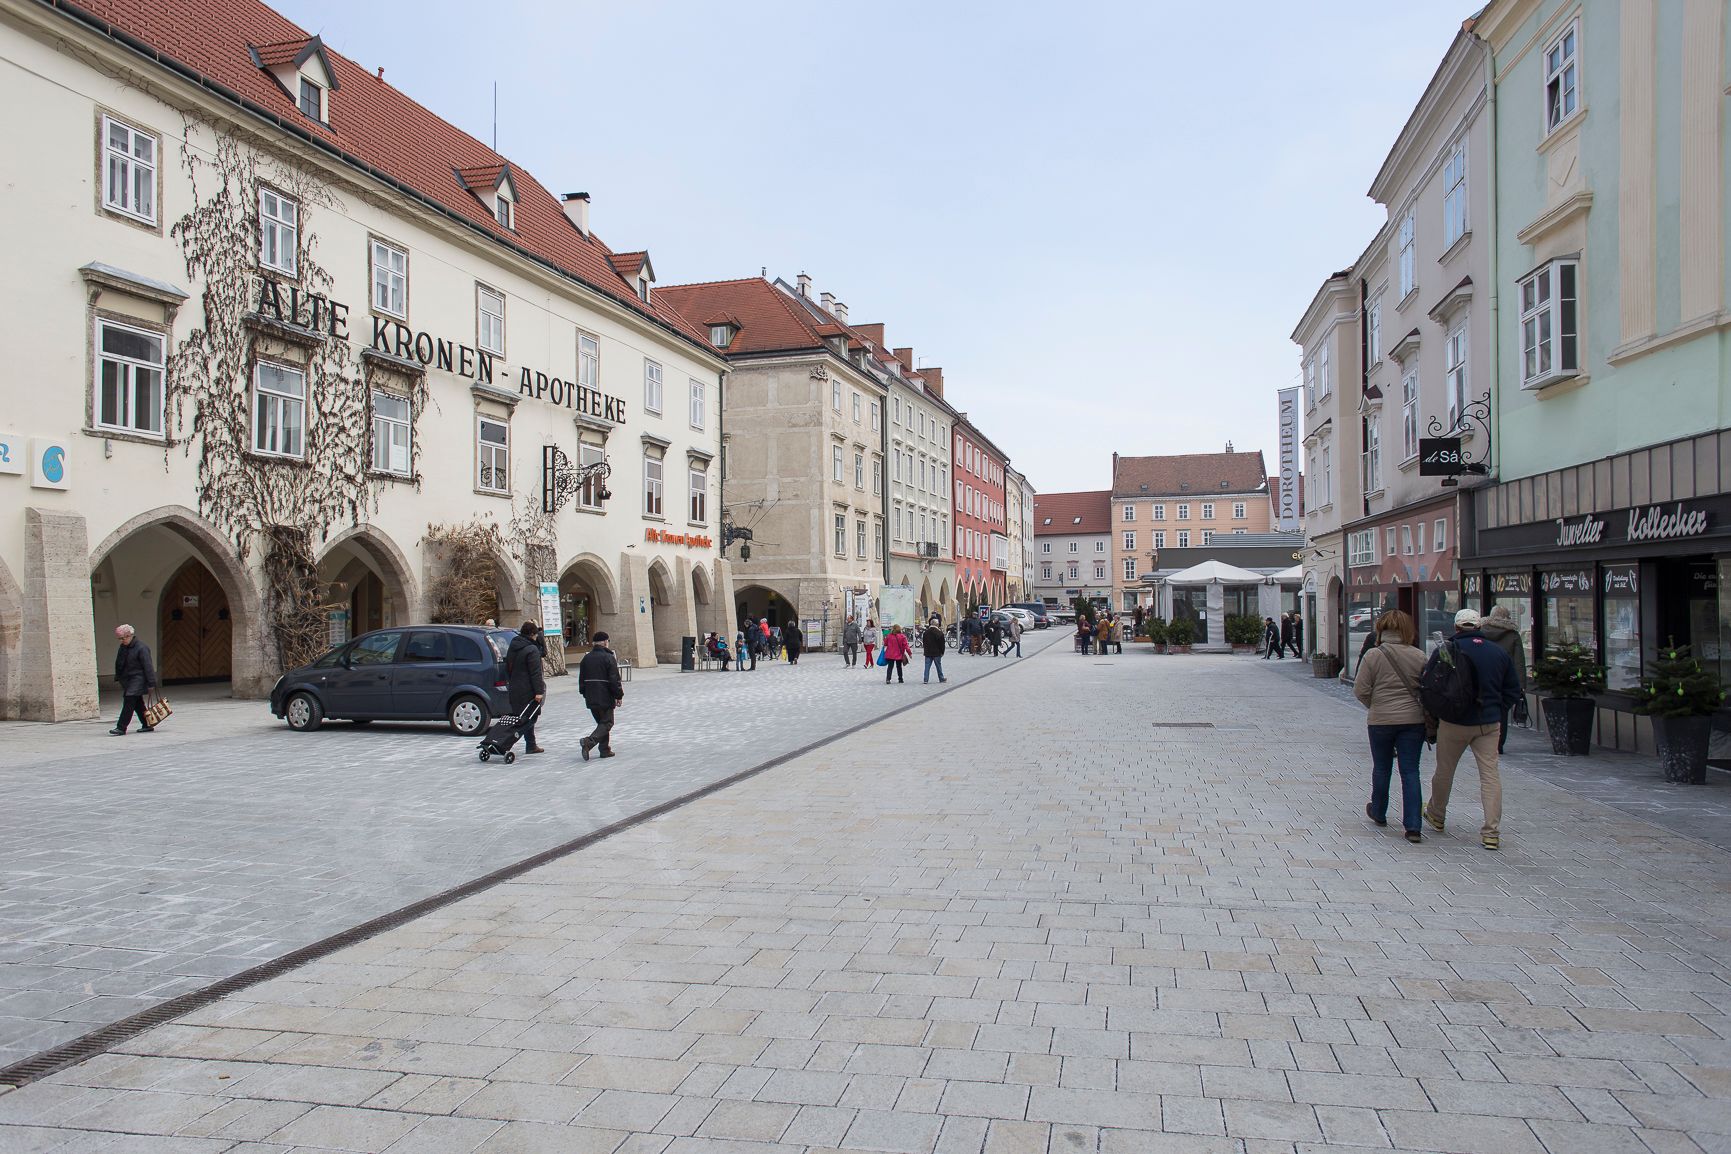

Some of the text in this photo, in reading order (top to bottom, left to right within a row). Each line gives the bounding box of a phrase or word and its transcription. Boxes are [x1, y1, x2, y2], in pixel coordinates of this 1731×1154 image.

[257, 279, 349, 341] ALTE
[369, 316, 493, 385] KRONEN
[519, 366, 626, 424] APOTHEKE
[1281, 399, 1294, 520] DOROTHEUM
[1440, 450, 1459, 463] Sá
[1556, 517, 1604, 547] Juwelier
